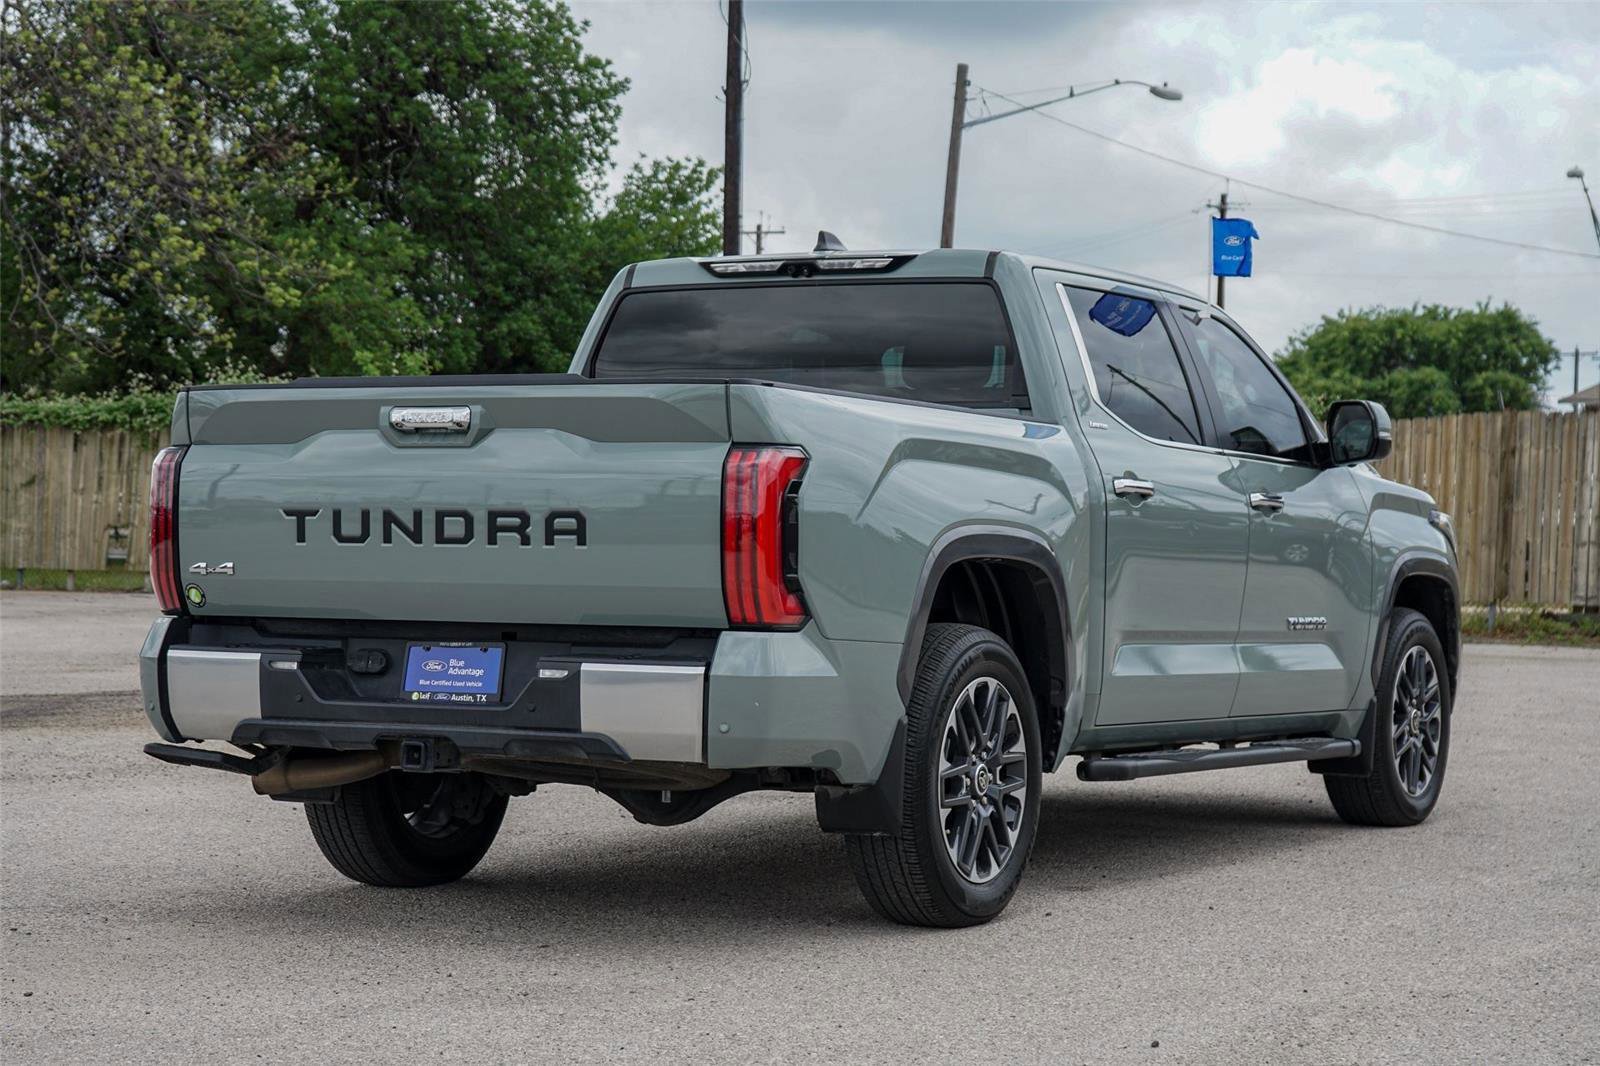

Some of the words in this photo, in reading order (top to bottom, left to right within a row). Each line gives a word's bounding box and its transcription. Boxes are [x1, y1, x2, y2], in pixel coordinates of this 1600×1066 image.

[280, 508, 587, 548] TUNDRA
[449, 659, 465, 667] Blue
[448, 667, 484, 677] Advantage
[451, 693, 475, 702] Austin,
[476, 694, 487, 702] TX
